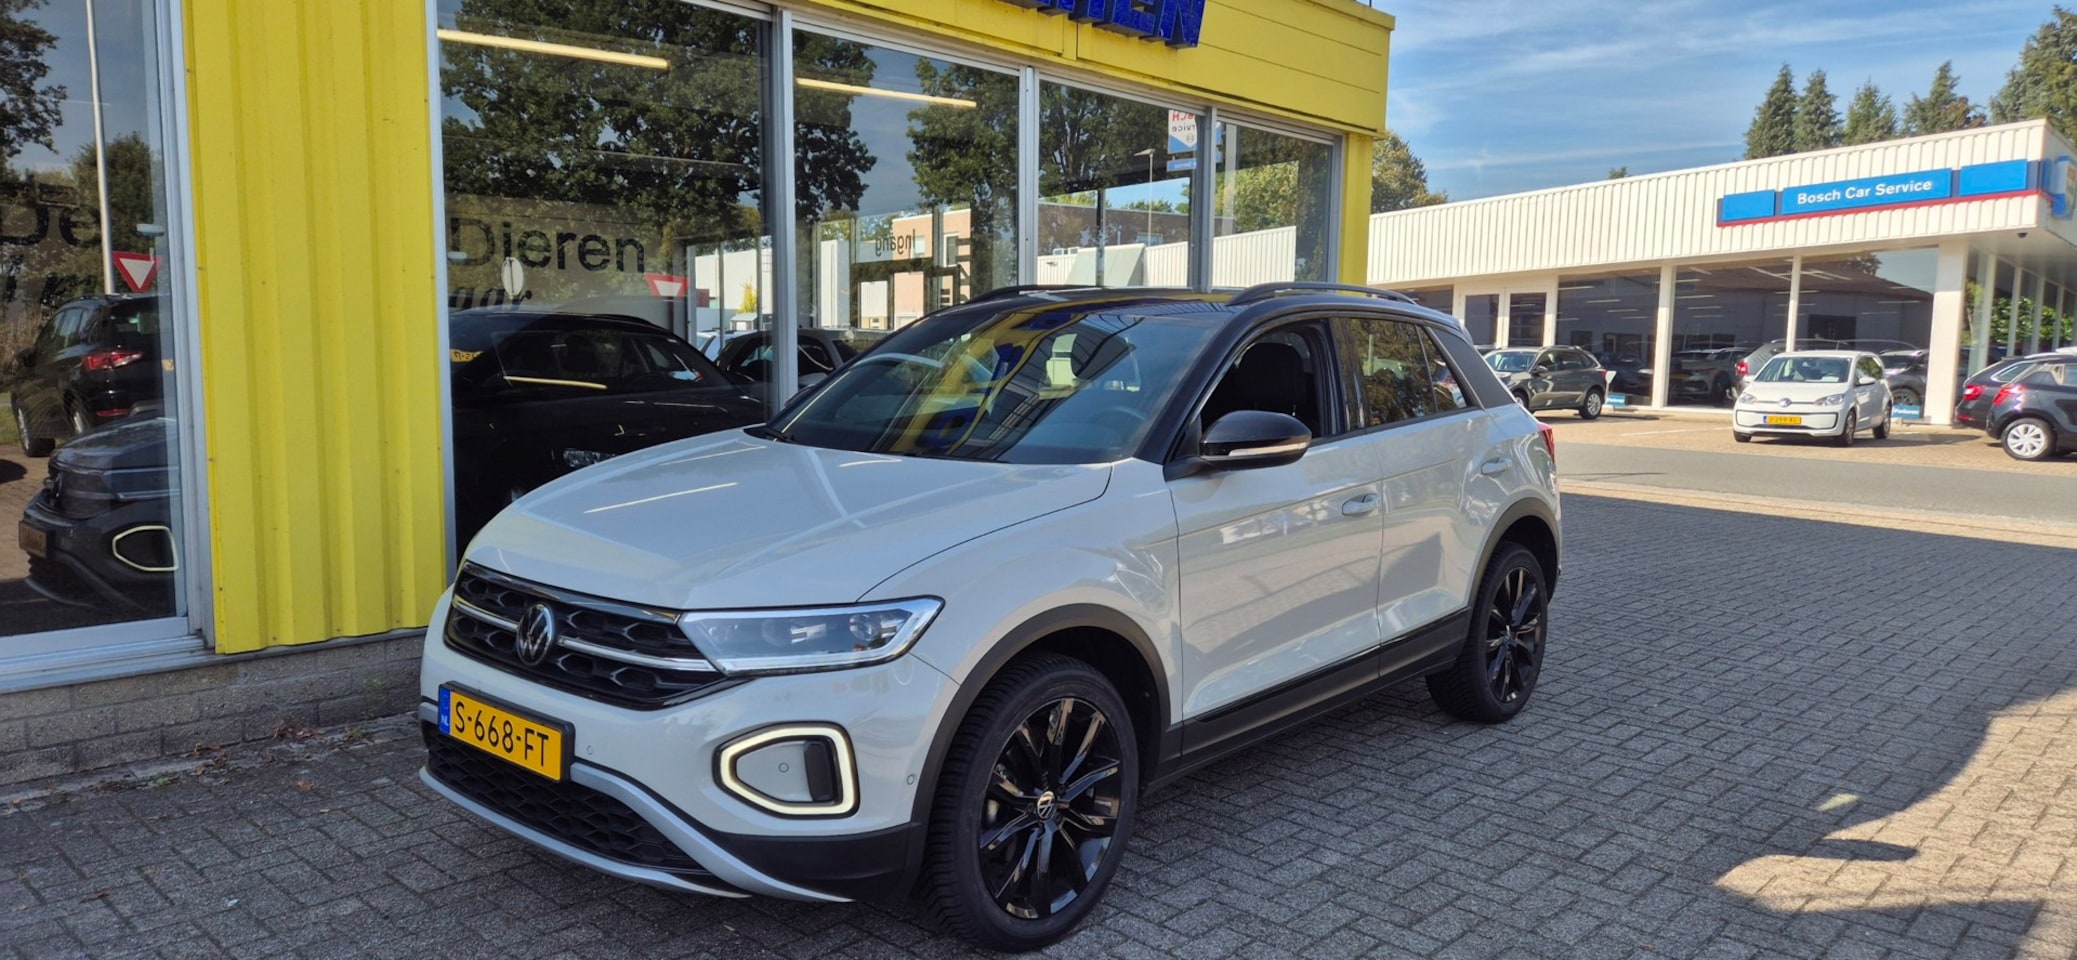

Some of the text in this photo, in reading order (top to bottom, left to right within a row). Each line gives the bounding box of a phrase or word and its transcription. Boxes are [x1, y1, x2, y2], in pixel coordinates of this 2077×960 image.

[1797, 180, 1932, 204] Bosch Car Service
[448, 217, 645, 272] Dieren
[455, 701, 549, 767] S-668-FT
